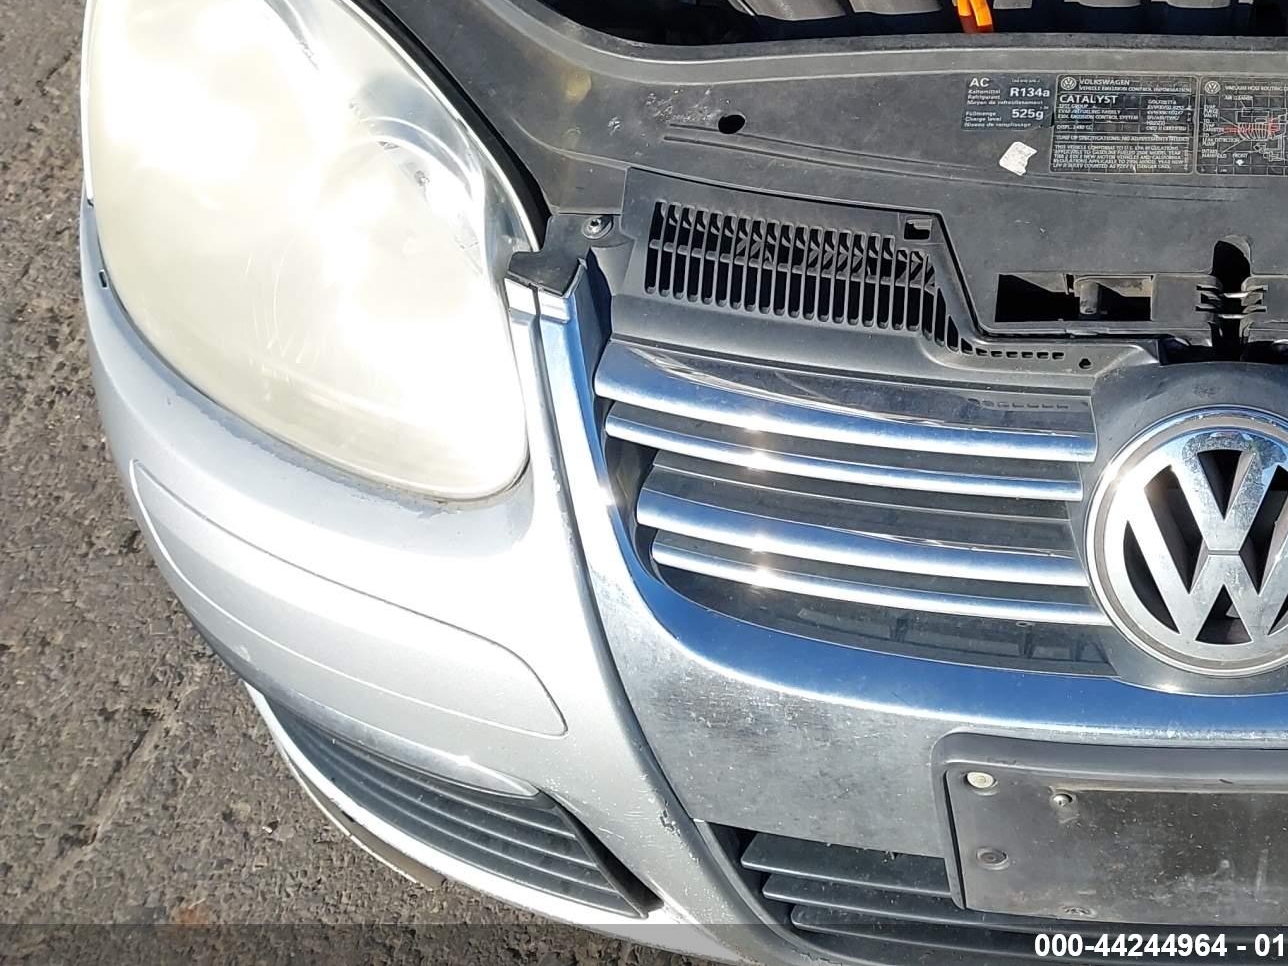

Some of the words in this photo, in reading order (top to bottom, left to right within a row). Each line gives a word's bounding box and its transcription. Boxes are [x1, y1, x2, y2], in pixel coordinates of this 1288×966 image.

[969, 77, 990, 87] AC
[1080, 78, 1130, 86] VOLKSWAGEN
[1009, 87, 1051, 97] R134a
[1060, 94, 1118, 104] CATALYST
[1011, 108, 1044, 120] 525g
